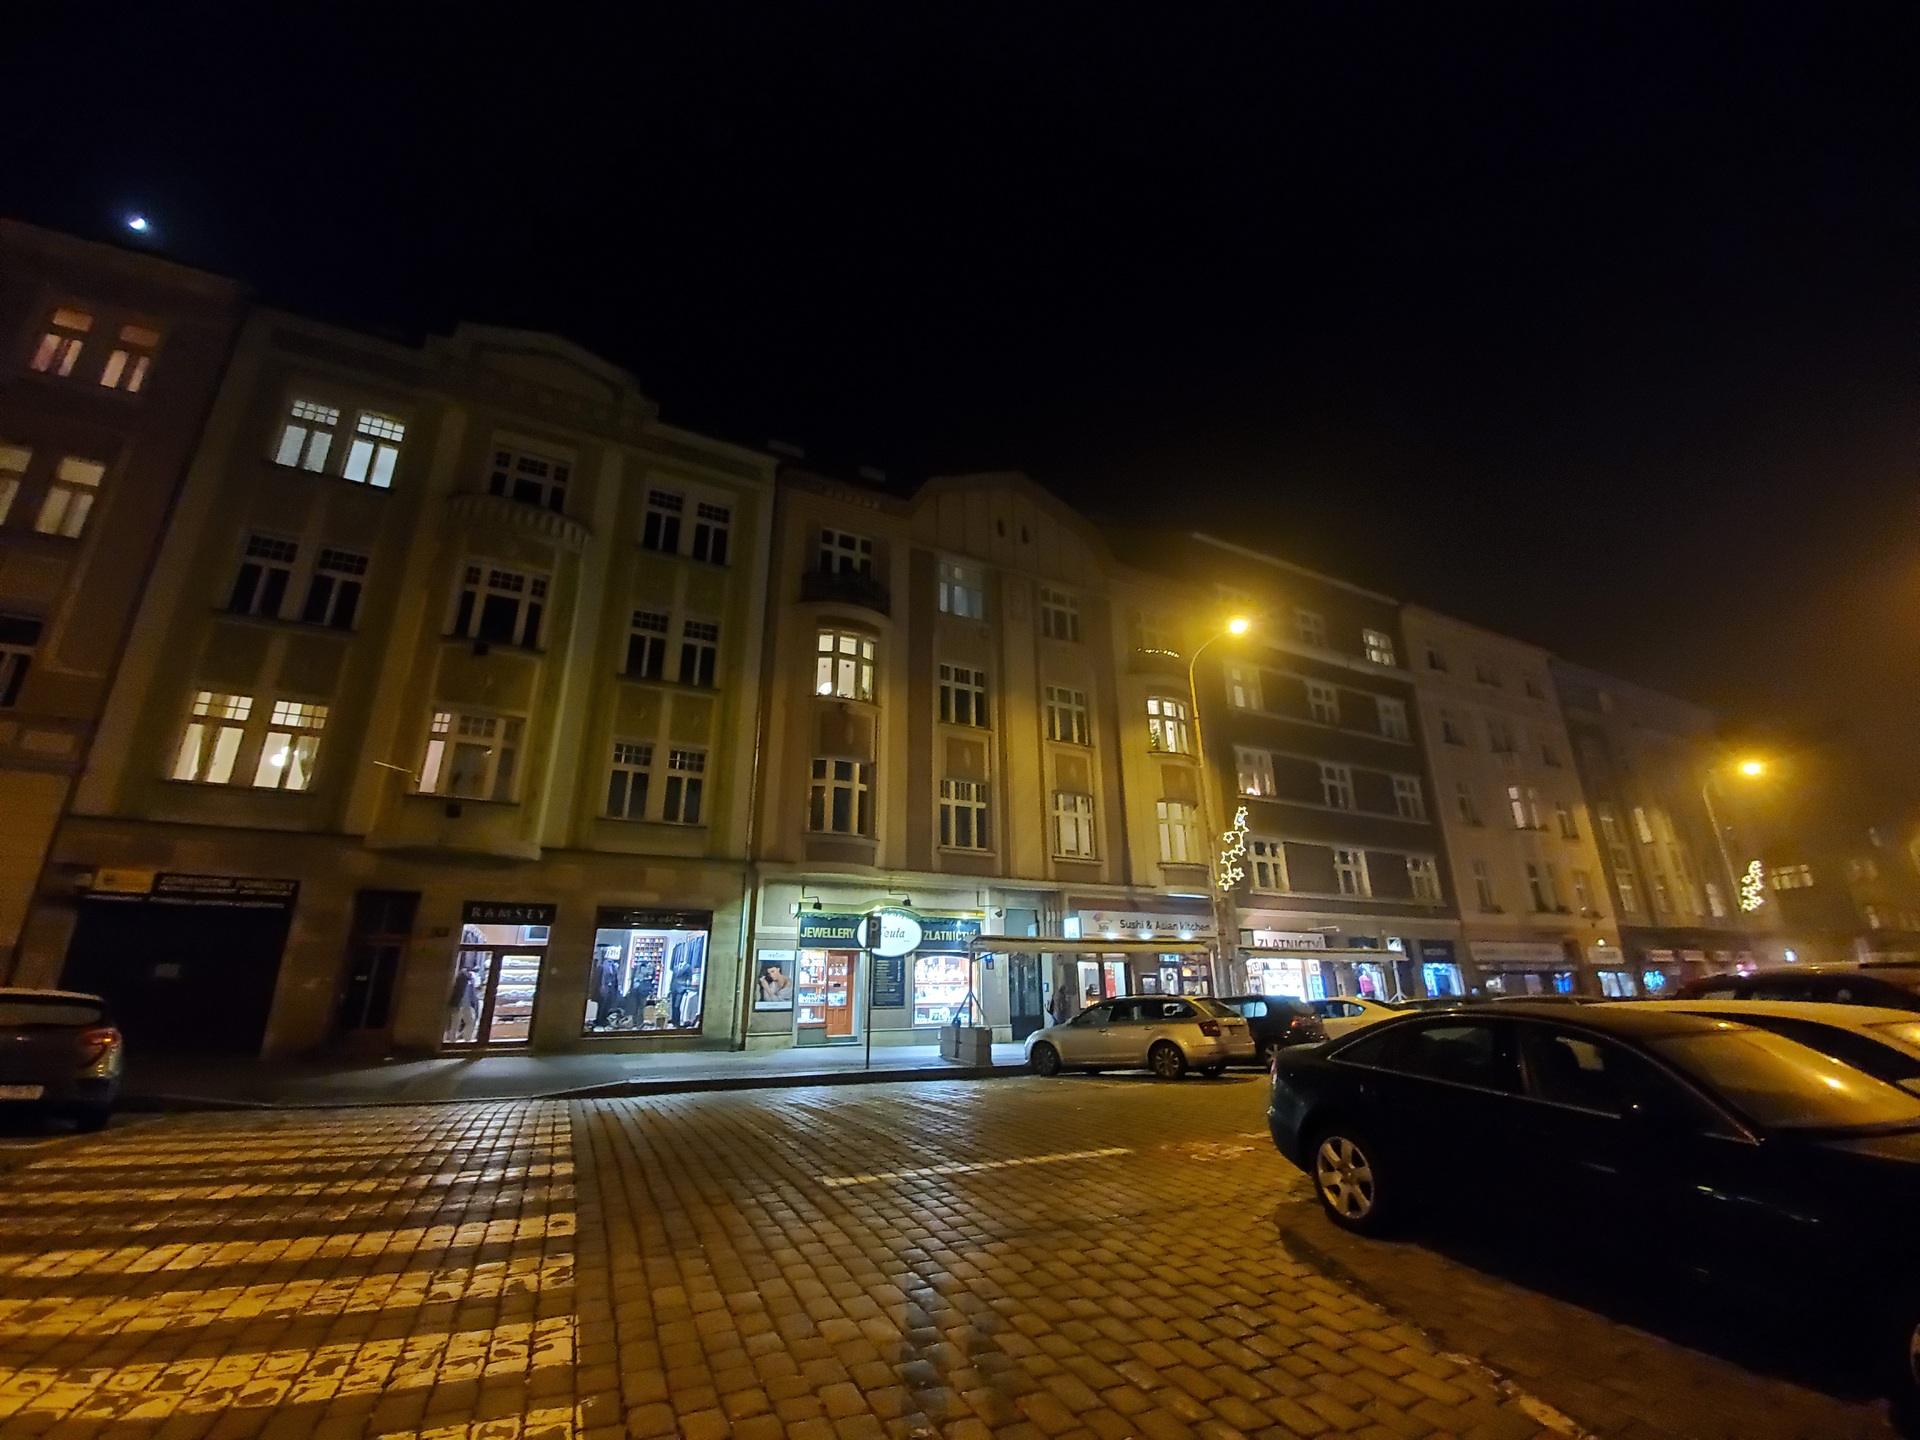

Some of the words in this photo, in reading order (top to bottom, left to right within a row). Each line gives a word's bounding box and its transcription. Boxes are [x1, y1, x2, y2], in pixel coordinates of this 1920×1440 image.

[471, 907, 547, 920] RAMSEY
[1119, 919, 1144, 930] Sushi
[1146, 920, 1152, 930] &
[1155, 921, 1178, 931] Asian
[800, 927, 856, 939] JEWELLERY
[882, 926, 906, 938] euta
